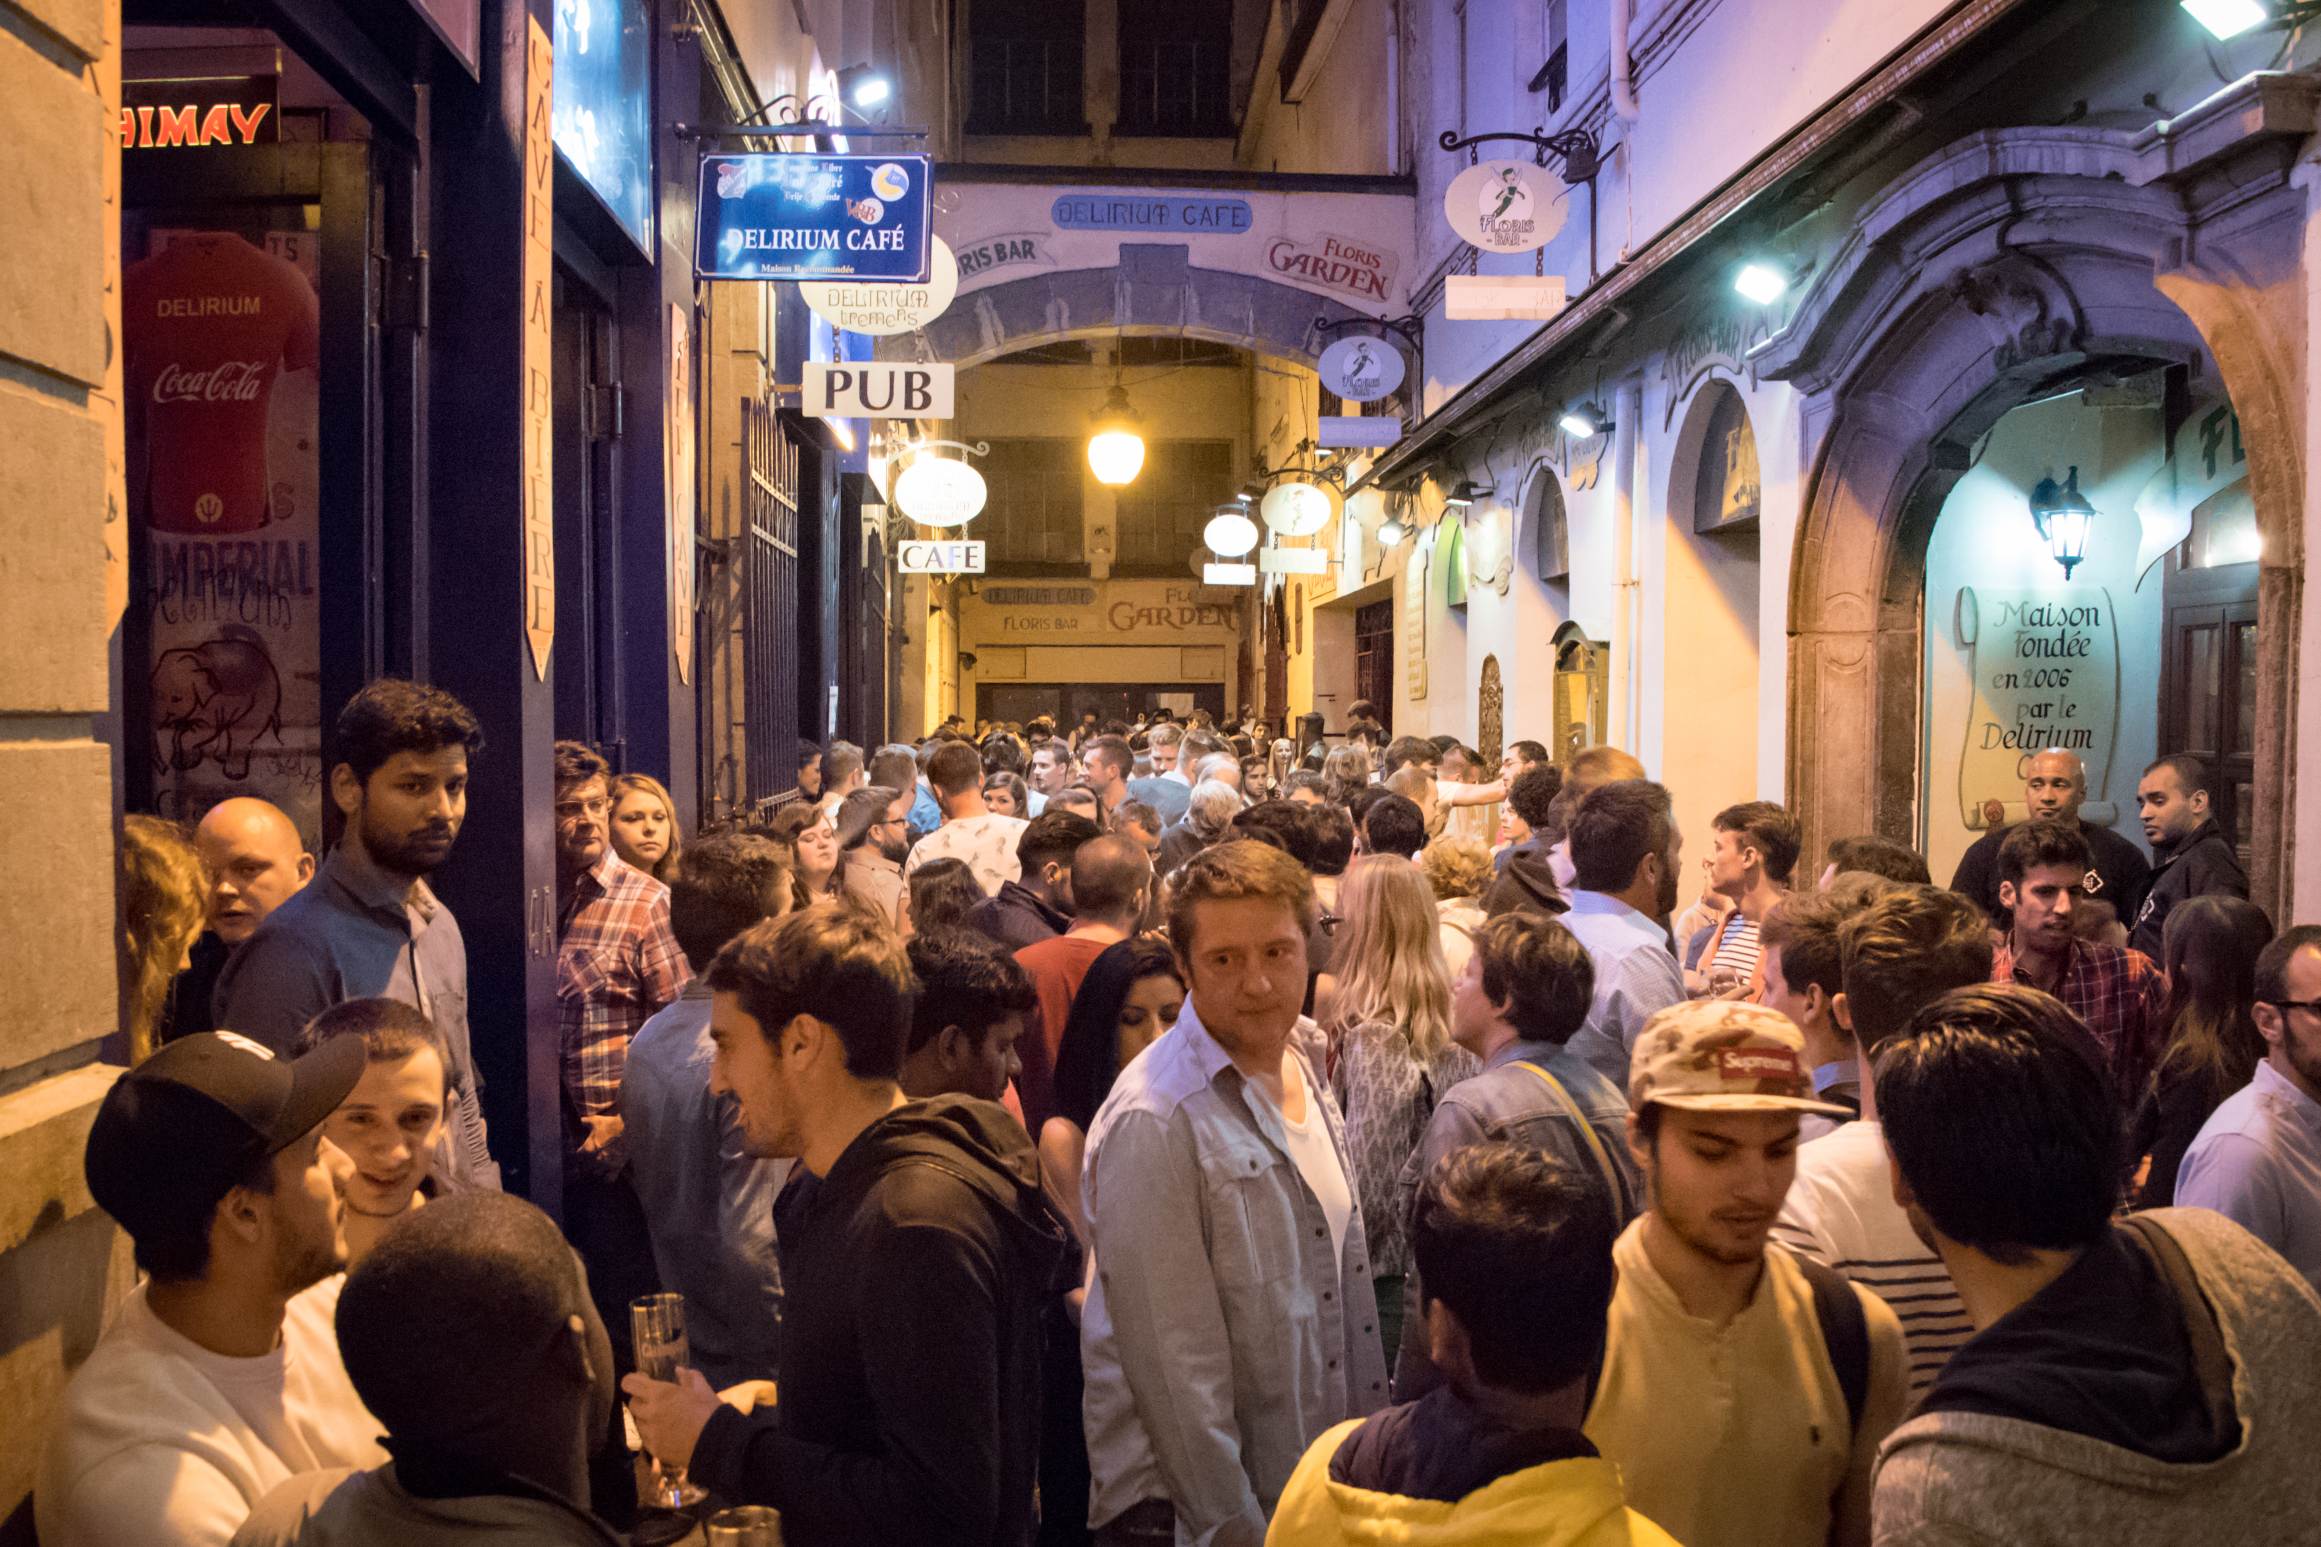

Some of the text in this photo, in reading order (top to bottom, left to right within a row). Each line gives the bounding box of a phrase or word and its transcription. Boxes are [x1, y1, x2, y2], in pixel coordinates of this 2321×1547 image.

[529, 39, 552, 251] CAVE
[1059, 201, 1246, 228] DELIRIUM CAFE
[727, 223, 905, 250] DELIRIUM CAFÉ
[993, 239, 1036, 262] BAR
[1323, 237, 1382, 270] FLORIS
[1268, 242, 1388, 301] GARDEN
[157, 296, 262, 318] DELIRIUM
[827, 288, 929, 308] DELIRIUM
[824, 369, 933, 411] PUB
[902, 545, 979, 569] CAFE
[1108, 600, 1236, 632] GARDEN
[1993, 600, 2101, 628] Maison
[1991, 667, 2073, 690] en 2006
[2016, 702, 2054, 727] par
[1979, 721, 2094, 751] Delirium
[1723, 1051, 1793, 1073] Supreme
